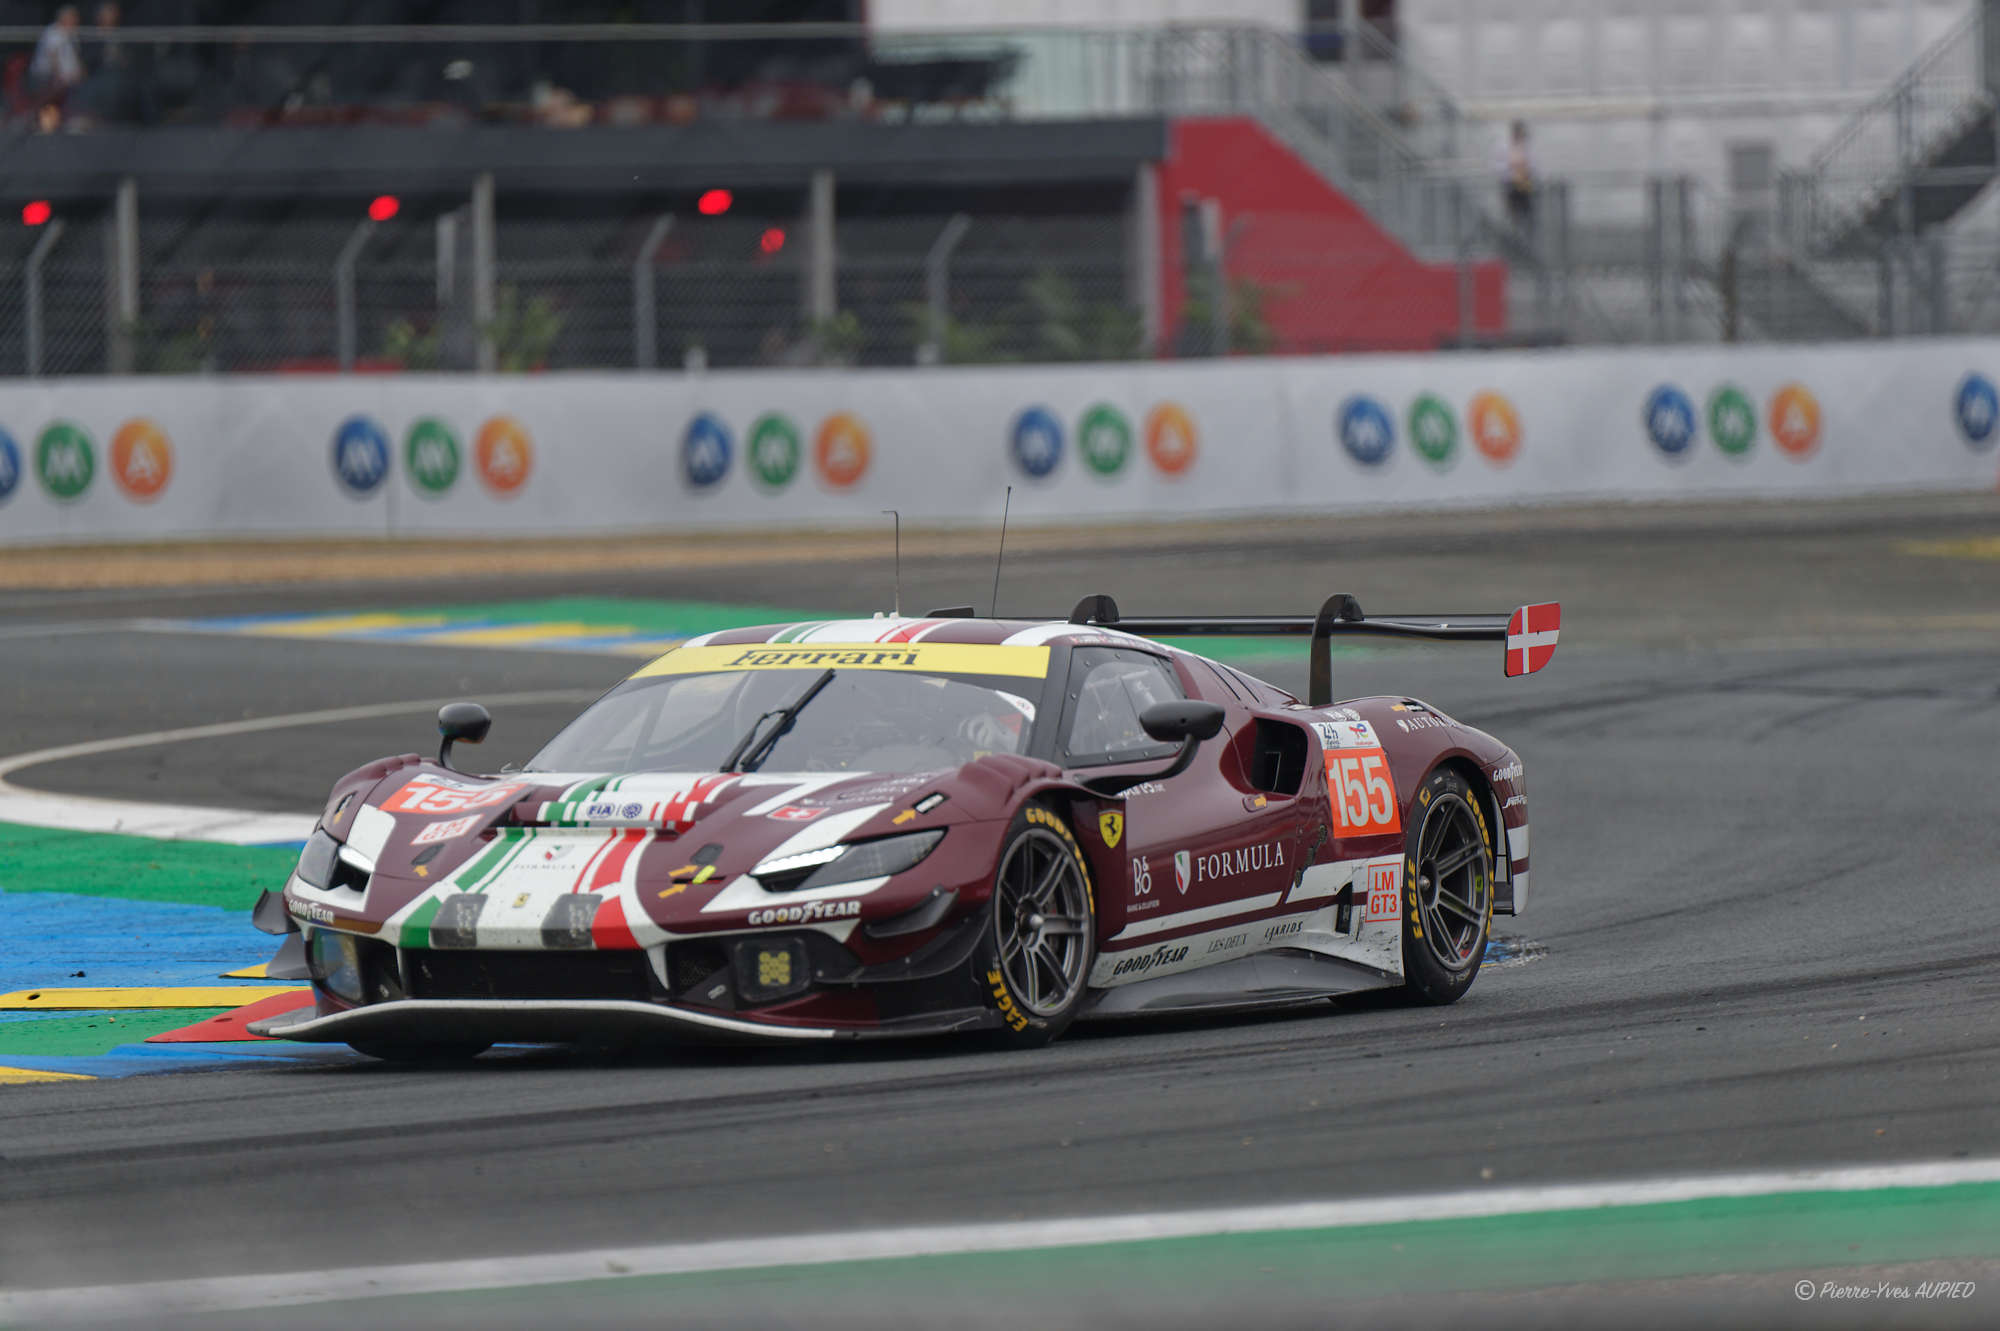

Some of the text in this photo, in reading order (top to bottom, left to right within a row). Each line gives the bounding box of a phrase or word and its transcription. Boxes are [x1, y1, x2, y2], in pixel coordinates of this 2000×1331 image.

[723, 649, 920, 667] Ferrari
[400, 785, 516, 811] 155
[1328, 755, 1394, 827] 155
[1198, 841, 1285, 882] FORMULA
[1374, 871, 1394, 891] LM
[1371, 893, 1397, 914] GT3
[1408, 857, 1424, 939] EAGLE
[748, 900, 862, 926] GOODYEAR
[1113, 945, 1189, 976] GOODYEAR
[987, 970, 1028, 1031] EAGLE
